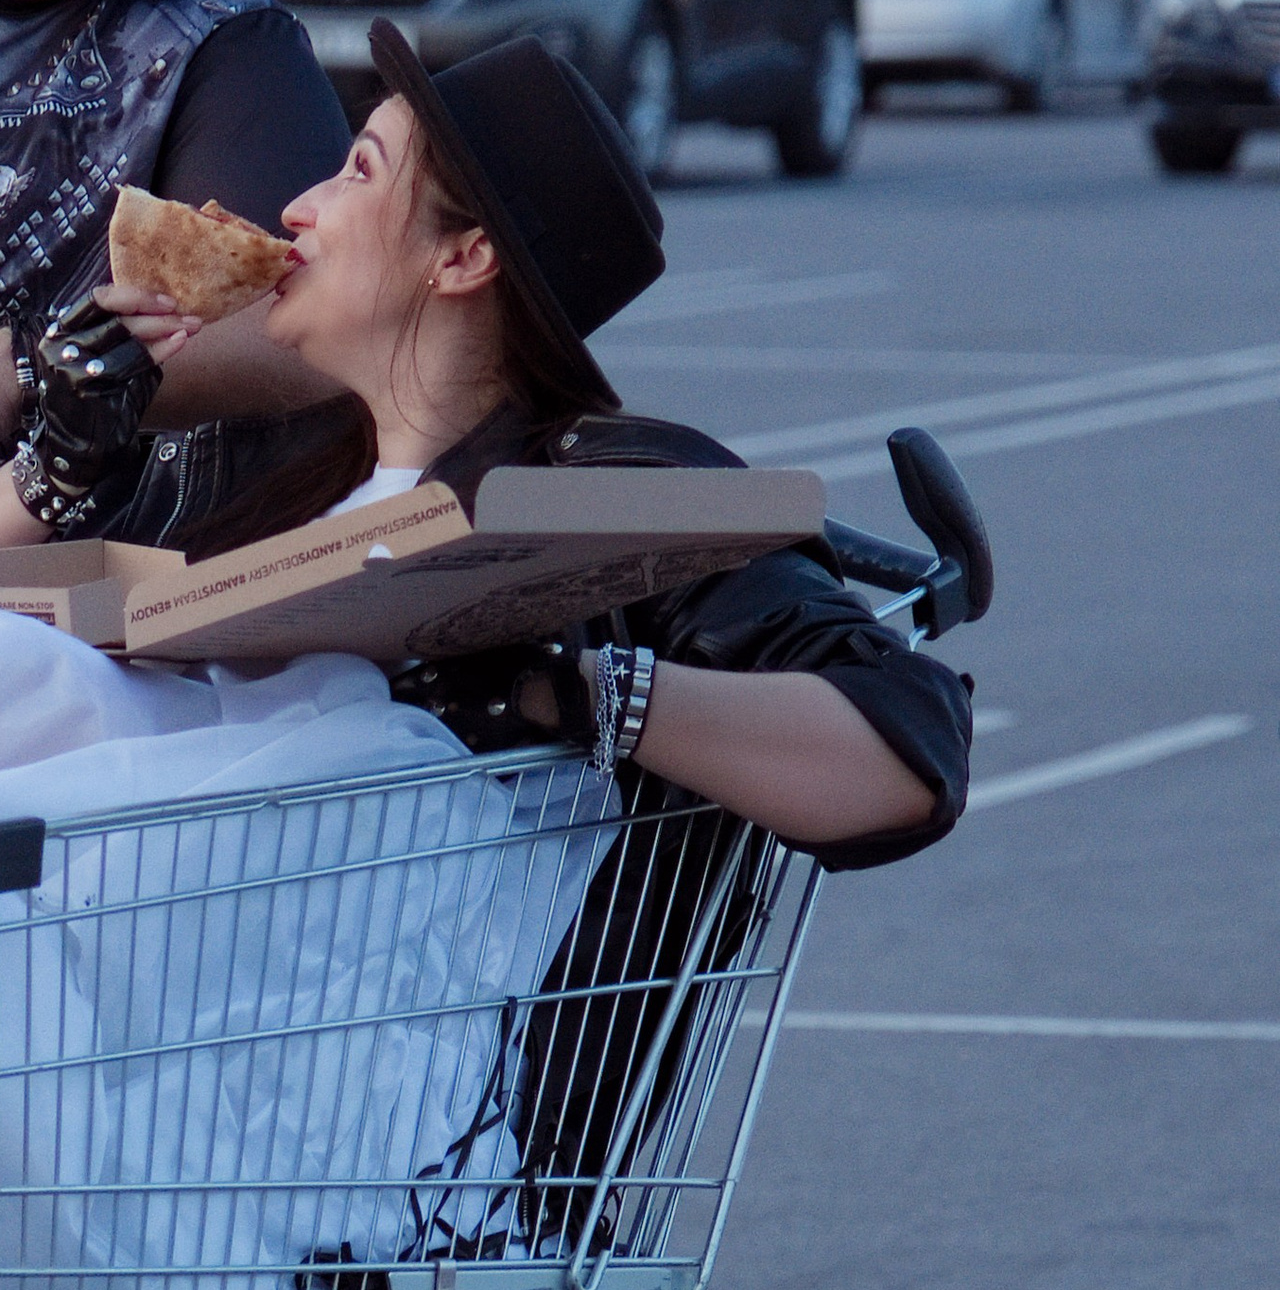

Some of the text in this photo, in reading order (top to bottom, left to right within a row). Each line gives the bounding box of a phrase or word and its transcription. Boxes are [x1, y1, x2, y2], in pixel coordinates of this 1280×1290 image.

[345, 500, 457, 551] #ANDYSRESTAURANT
[248, 541, 343, 583] #ANDYSDELIVERY
[18, 601, 55, 611] NON-STOP
[173, 574, 247, 609] #ANDYSTEAM
[130, 599, 172, 624] #ENJOY
